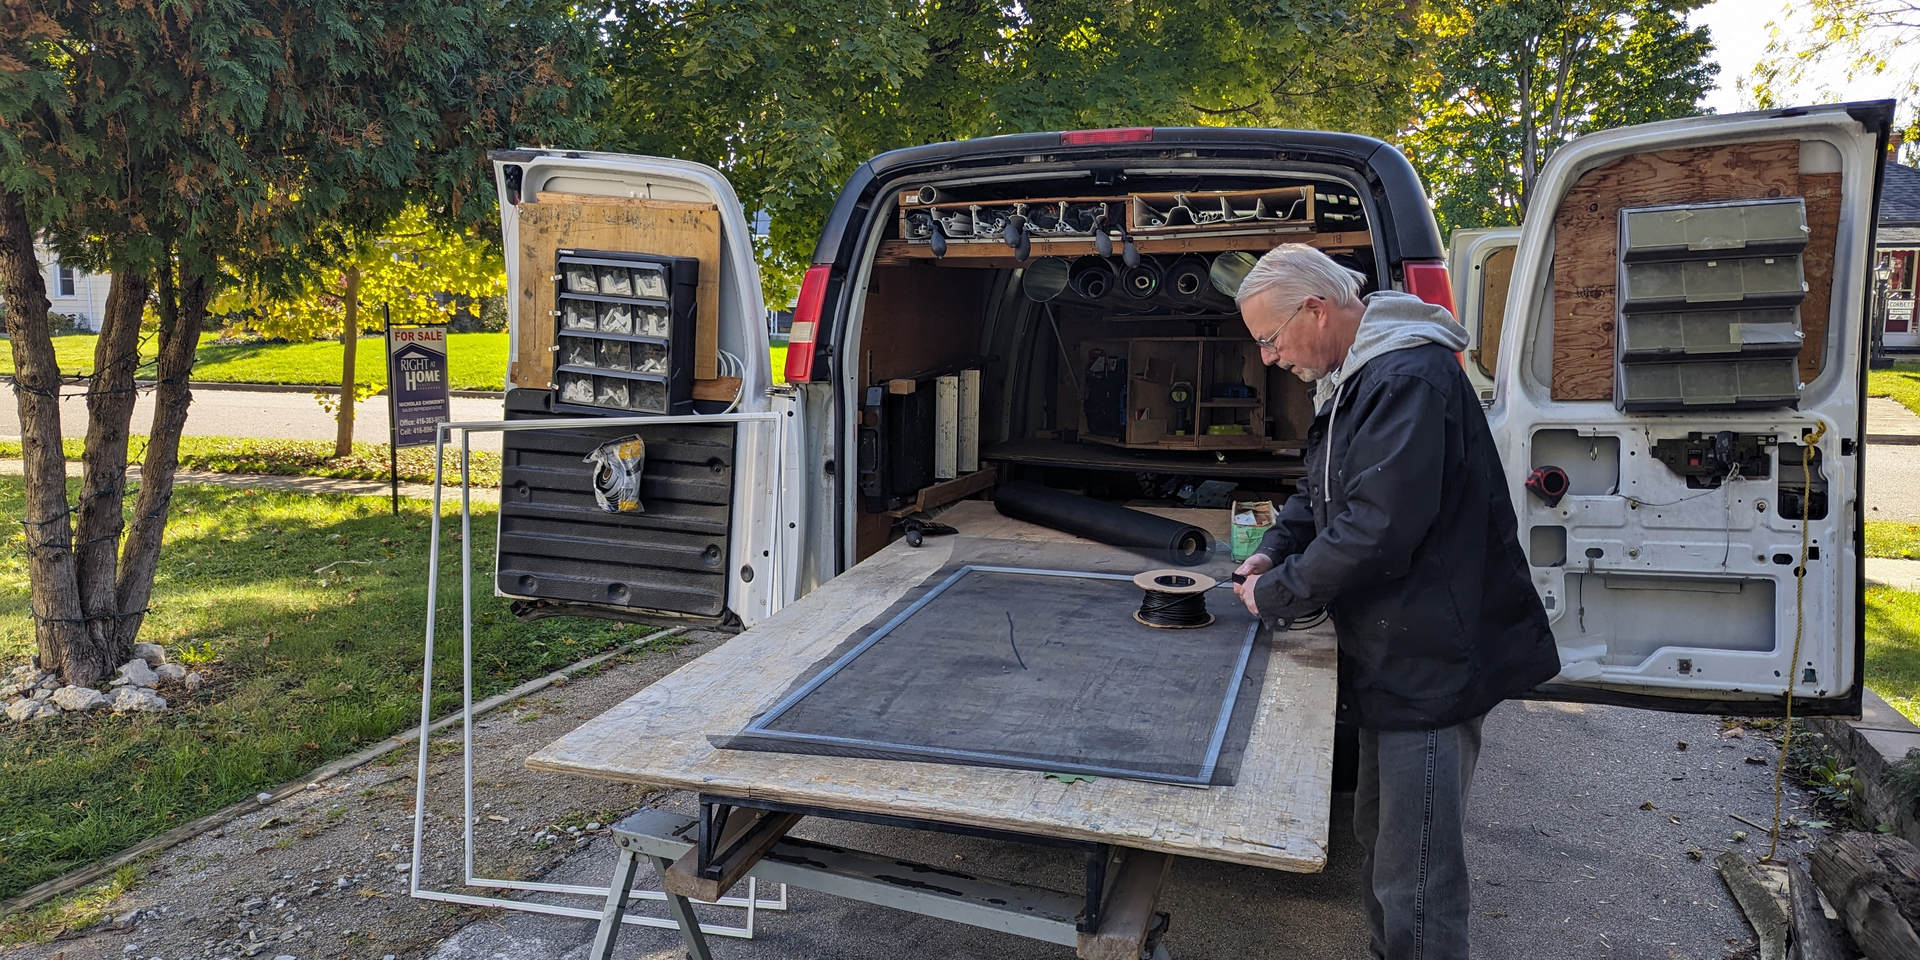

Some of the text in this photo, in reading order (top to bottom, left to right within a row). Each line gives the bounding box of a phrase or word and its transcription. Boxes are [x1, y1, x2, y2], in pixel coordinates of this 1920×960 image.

[394, 330, 443, 341] FOR SALE
[400, 358, 429, 371] RIGHT
[405, 370, 440, 391] HOME
[400, 418, 416, 426] Office:
[400, 427, 412, 436] Cell:
